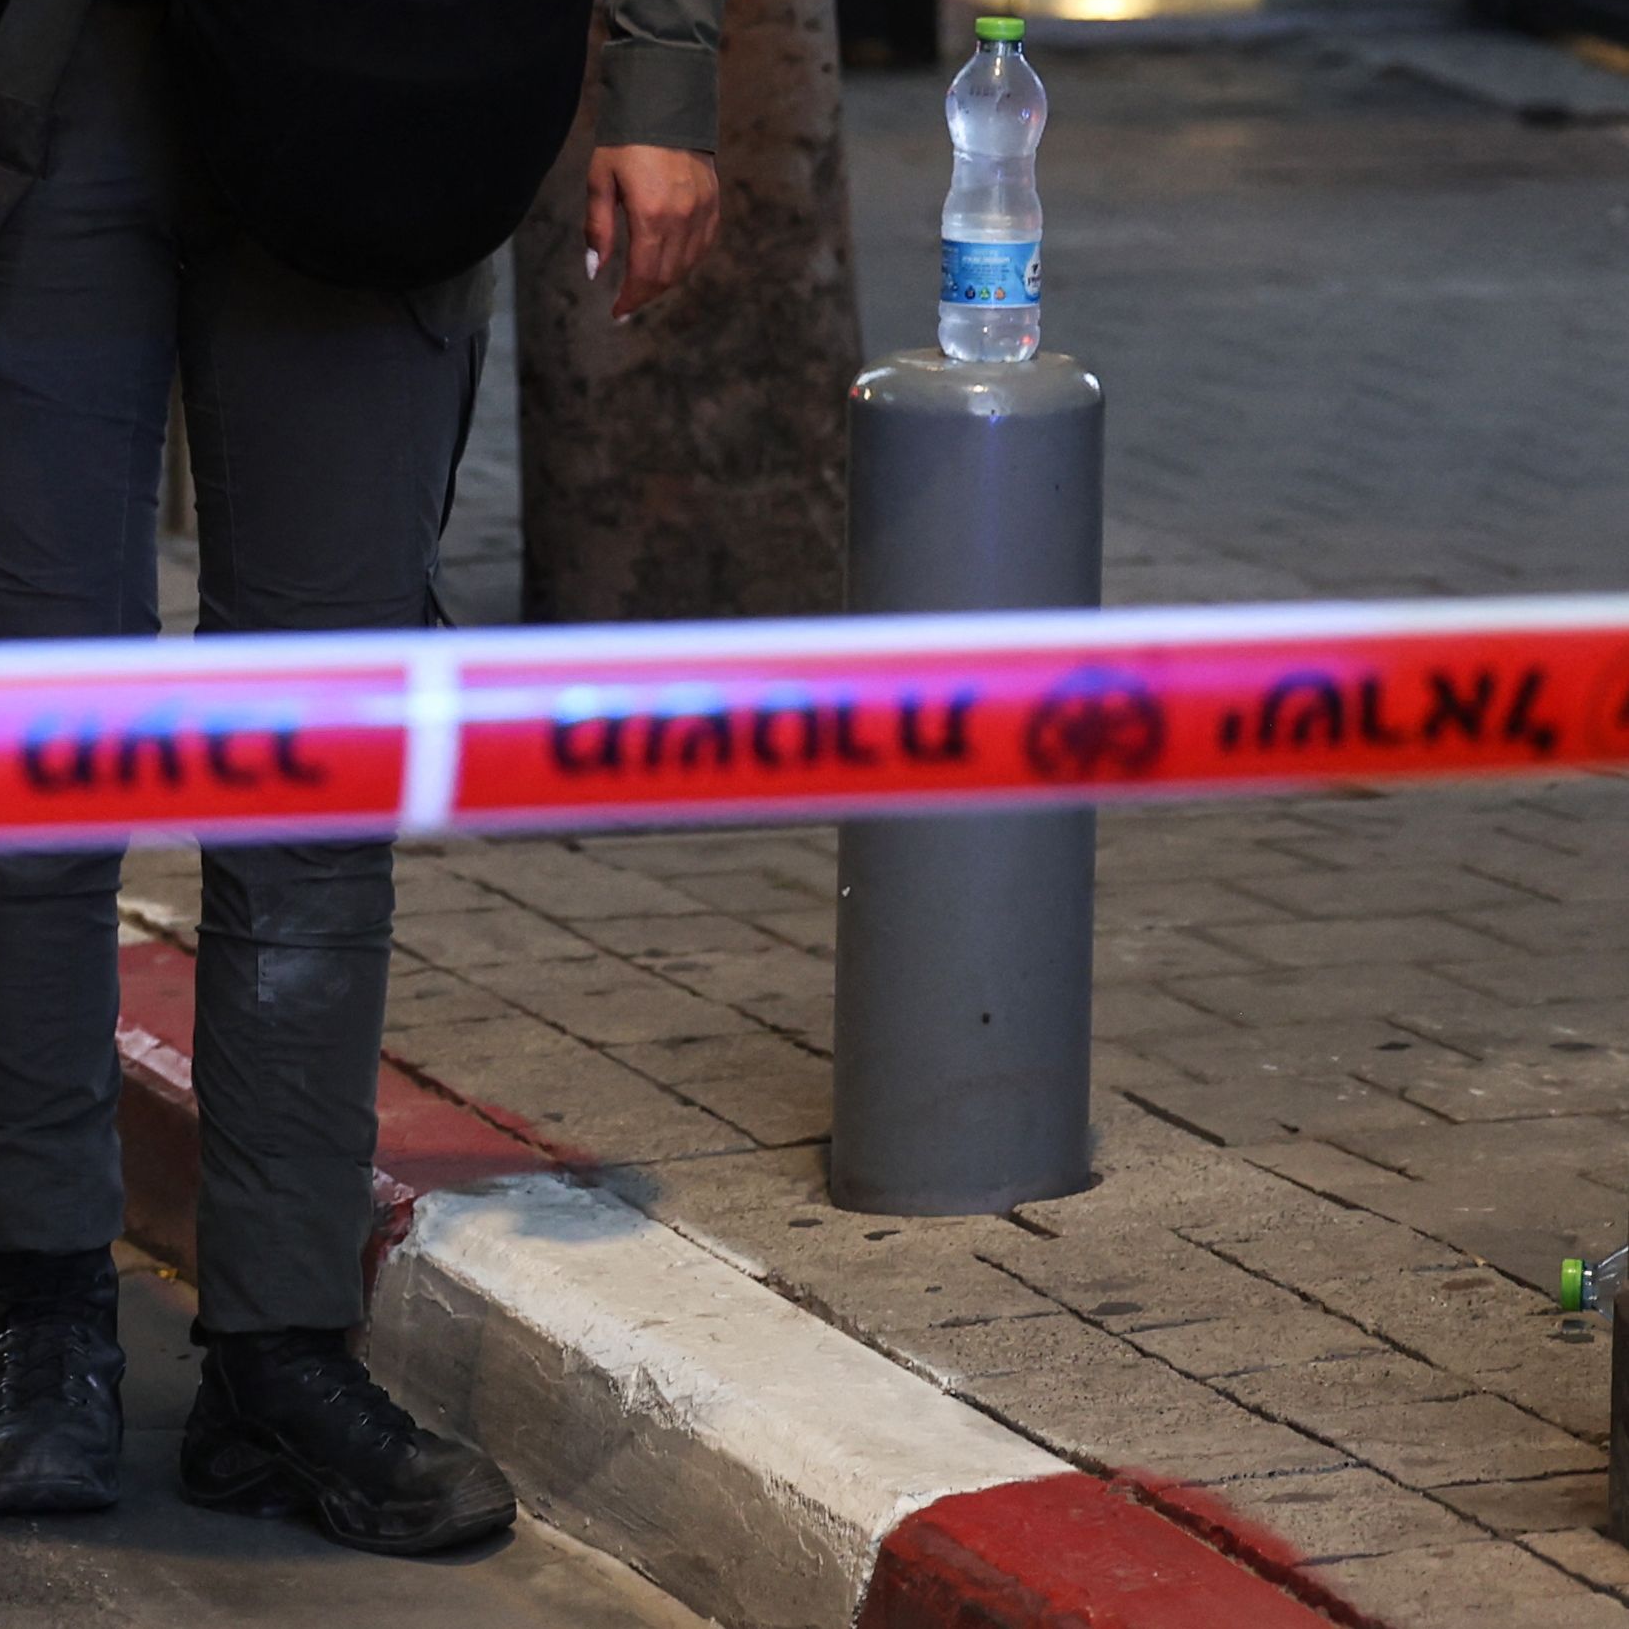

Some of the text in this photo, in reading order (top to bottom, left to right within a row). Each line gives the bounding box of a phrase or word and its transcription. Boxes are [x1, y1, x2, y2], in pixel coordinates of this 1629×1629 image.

[24, 703, 327, 793] מעבר
[548, 667, 1555, 775] משטרת ישראל
